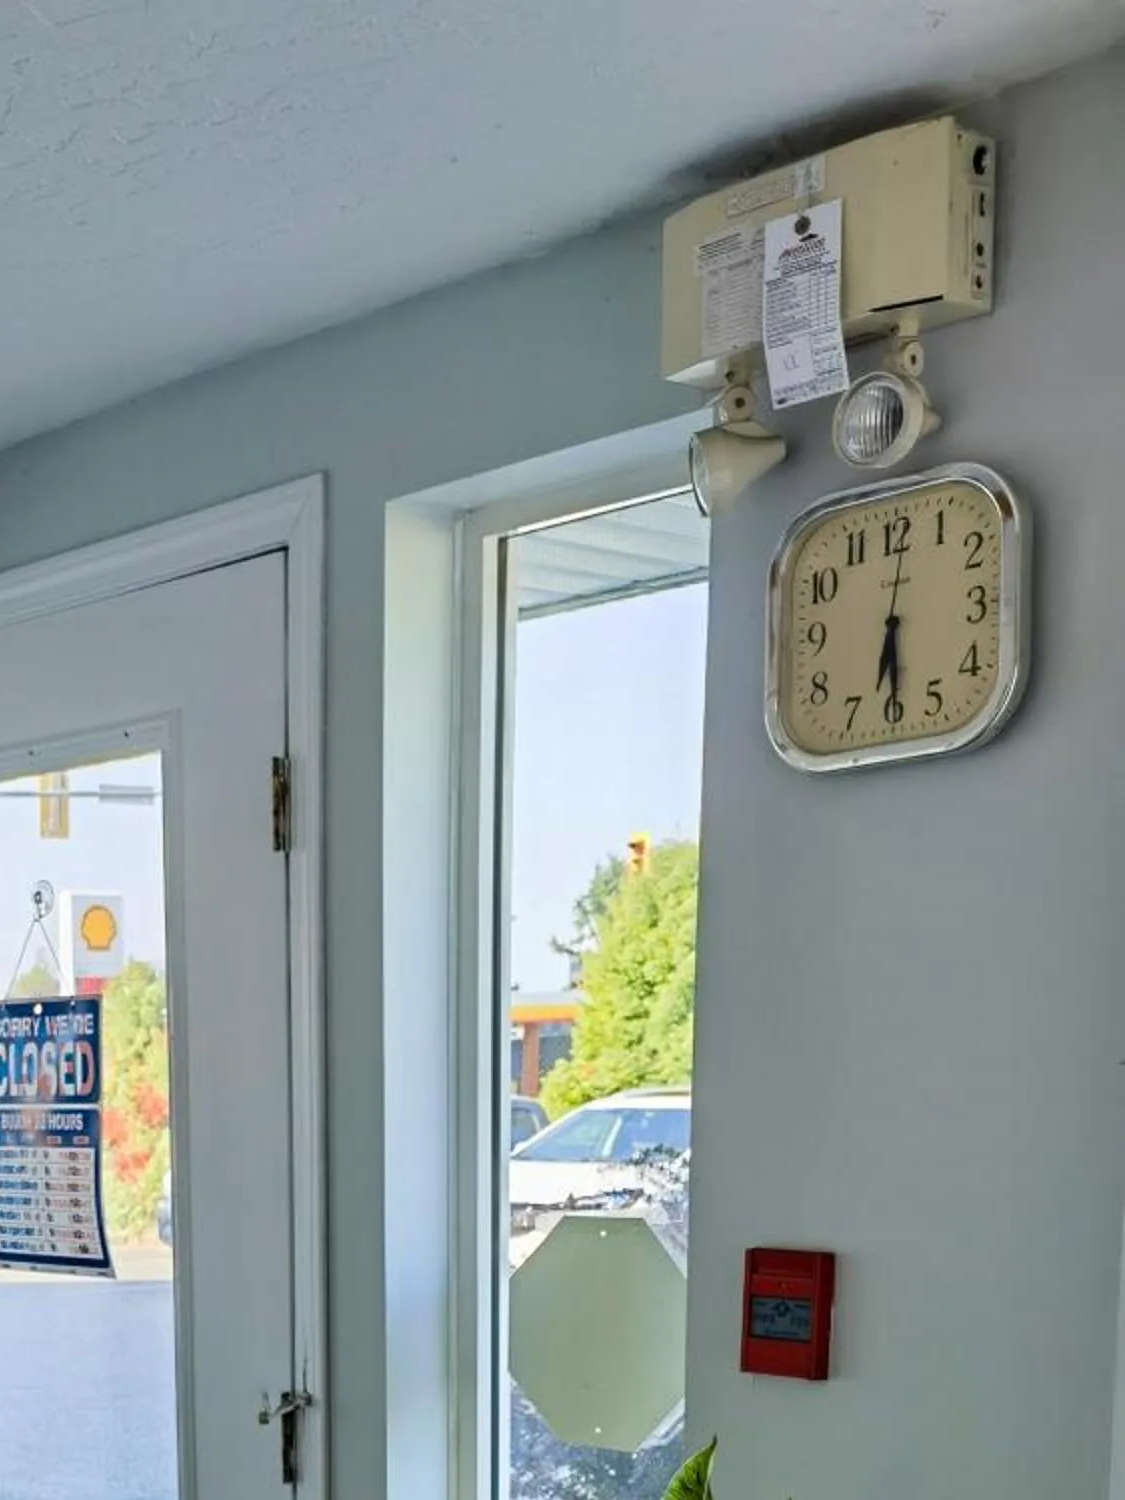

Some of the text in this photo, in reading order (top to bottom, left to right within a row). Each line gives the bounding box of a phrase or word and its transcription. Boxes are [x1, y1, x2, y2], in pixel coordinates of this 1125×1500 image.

[882, 517, 910, 556] 12
[934, 510, 945, 545] 1
[846, 530, 865, 566] 11
[963, 532, 984, 570] 2
[811, 567, 838, 604] 10
[966, 585, 987, 624] 3
[808, 622, 827, 657] 9
[958, 640, 981, 677] 4
[810, 672, 828, 706] 8
[924, 678, 943, 716] 5
[844, 696, 862, 731] 7
[884, 695, 904, 724] 6
